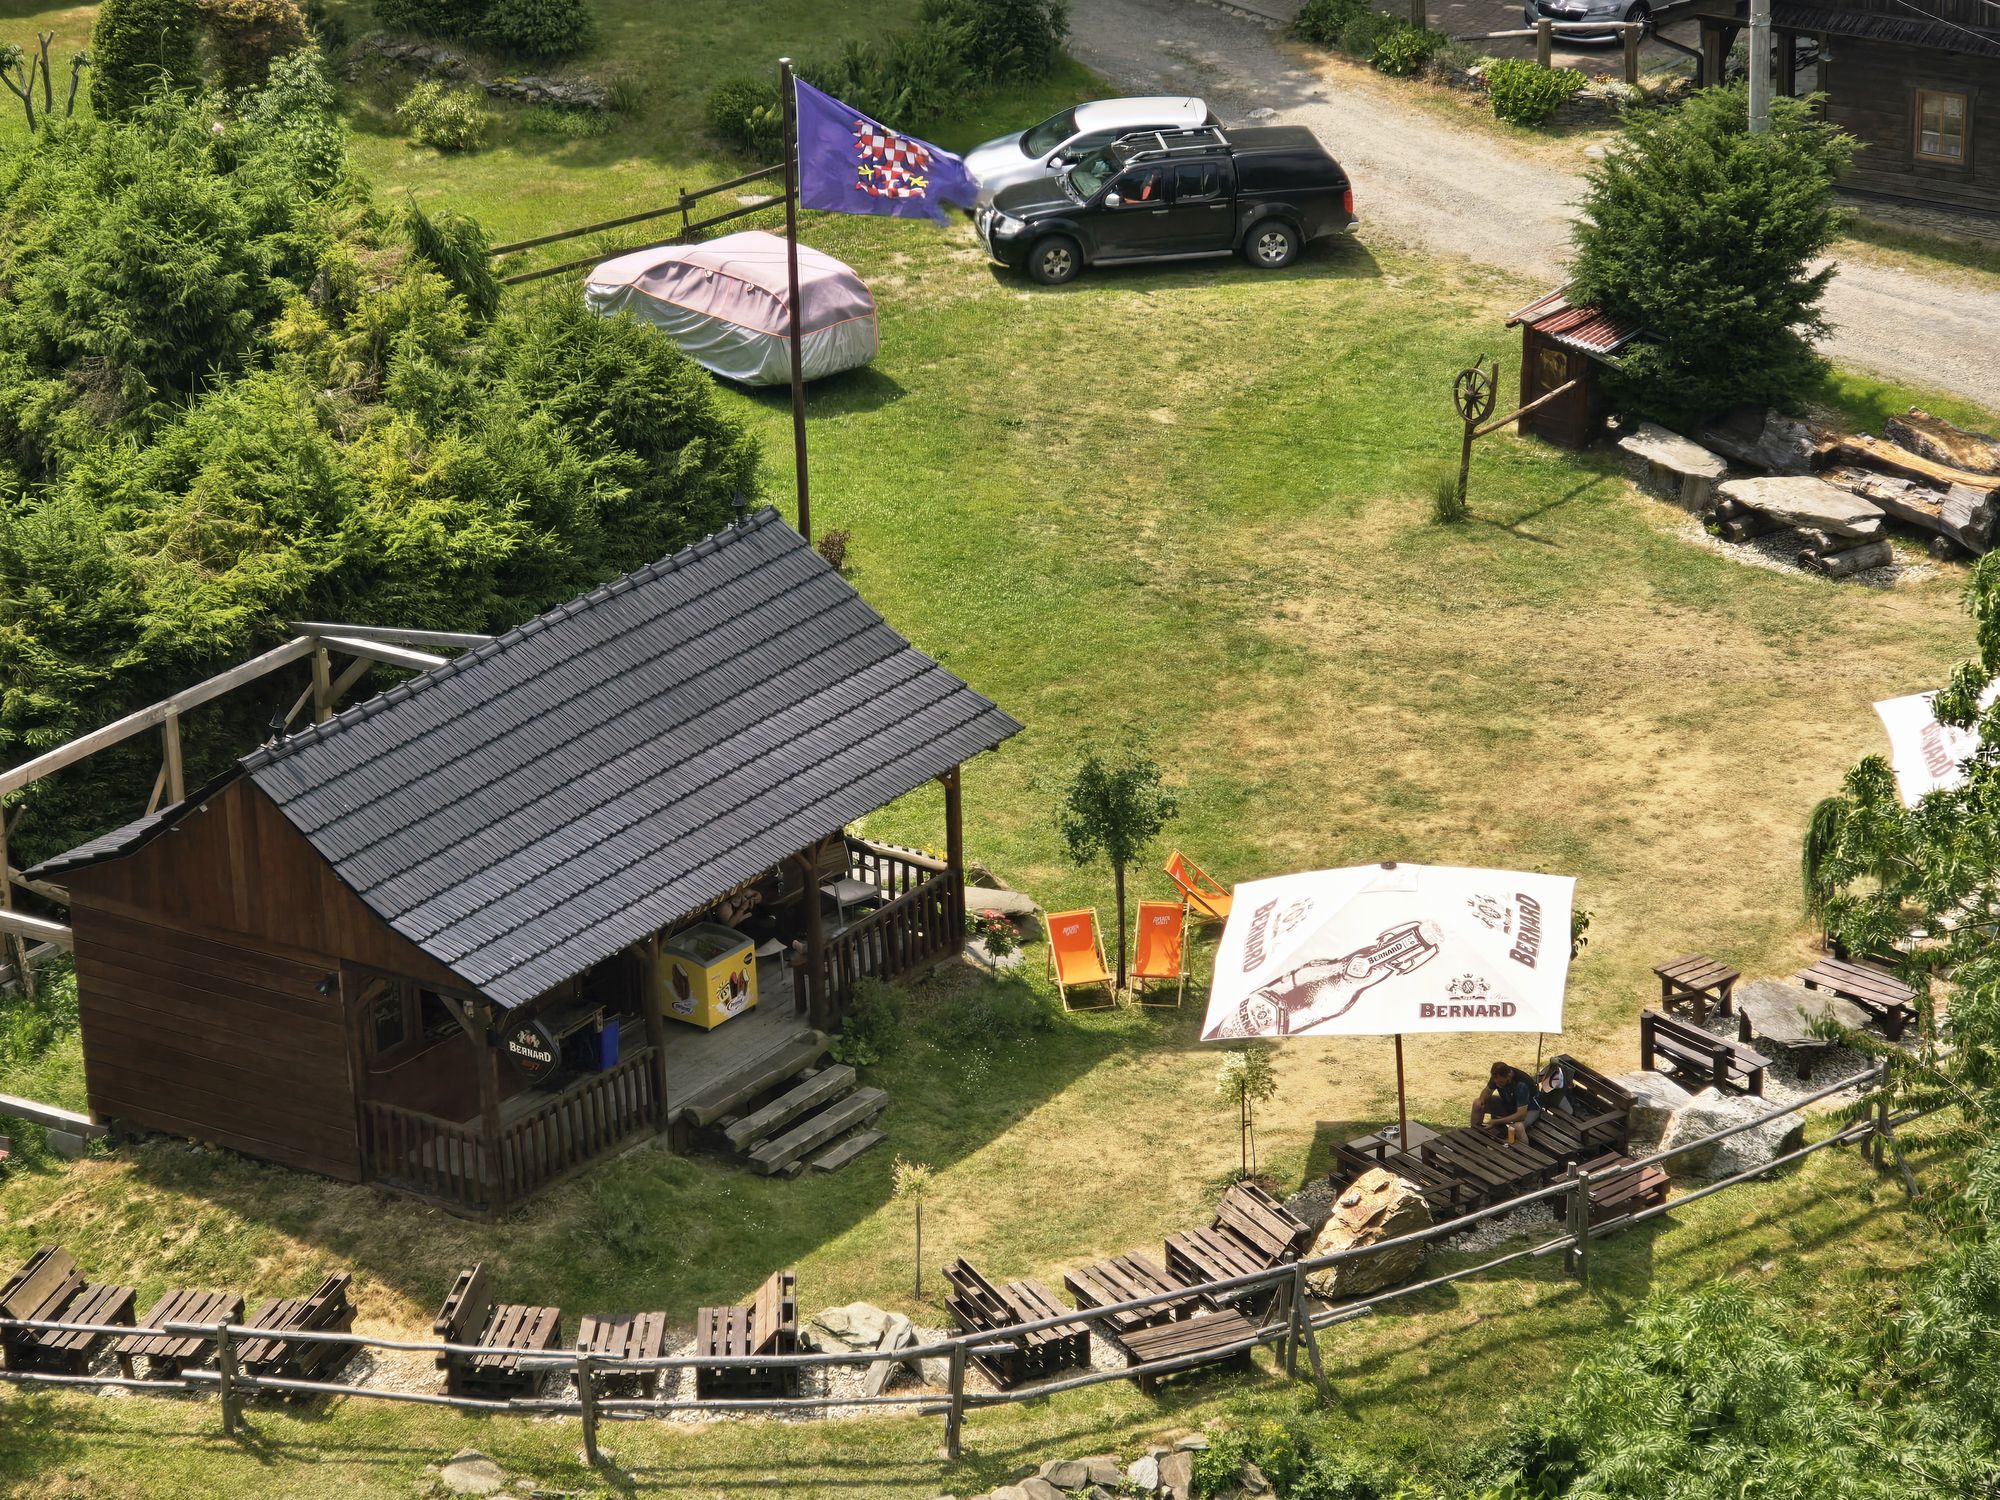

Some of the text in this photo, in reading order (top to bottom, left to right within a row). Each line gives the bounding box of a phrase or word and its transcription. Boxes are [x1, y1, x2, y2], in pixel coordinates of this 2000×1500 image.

[1921, 721, 1954, 777] BNARD
[1243, 897, 1278, 972] BERNARD
[1509, 893, 1540, 968] BERNARD
[1367, 943, 1403, 964] BERNARD
[1419, 1002, 1517, 1018] BERNARD
[509, 1041, 551, 1062] BERNARD
